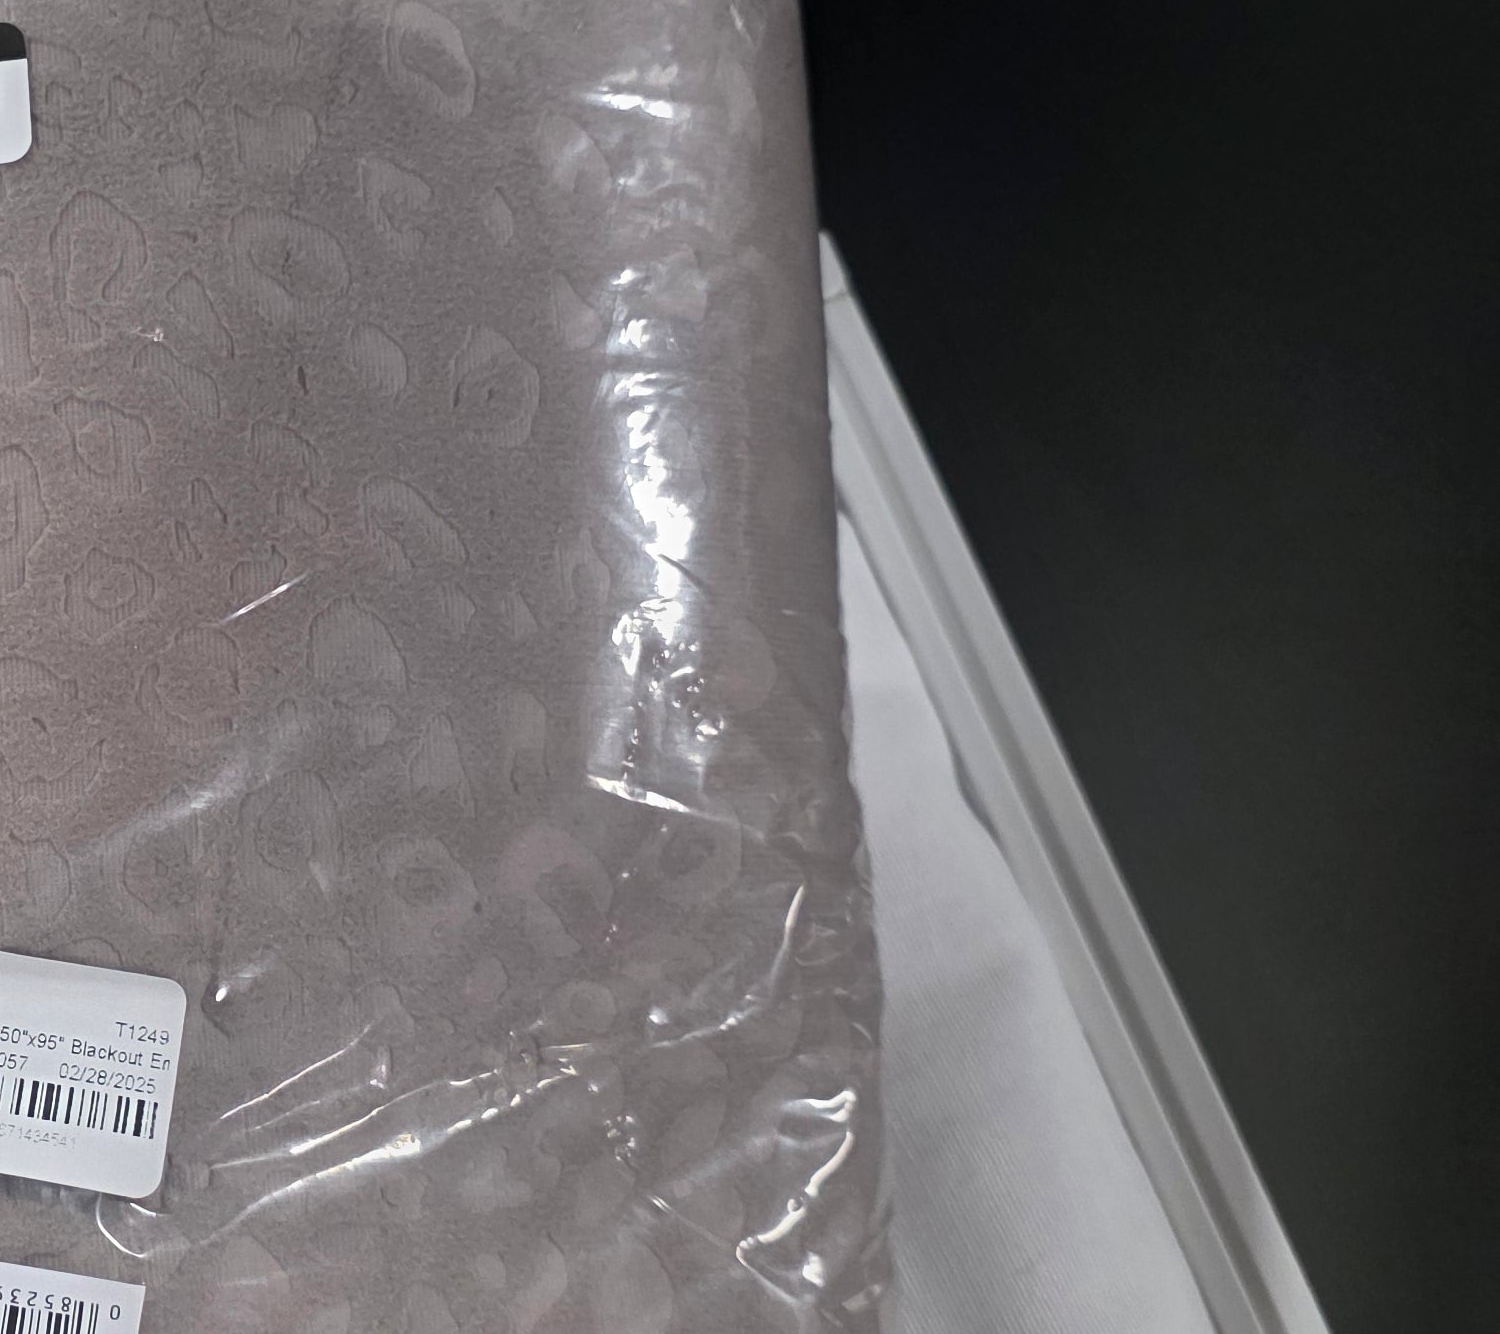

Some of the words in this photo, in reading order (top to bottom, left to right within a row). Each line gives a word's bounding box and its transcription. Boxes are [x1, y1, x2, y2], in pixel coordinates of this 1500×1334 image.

[115, 1021, 170, 1046] T1249
[0, 1026, 65, 1051] 50"x95"
[71, 1038, 143, 1067] Blackout
[150, 1053, 171, 1072] En
[58, 1062, 157, 1095] 02/28/2025
[109, 1304, 122, 1320] 0
